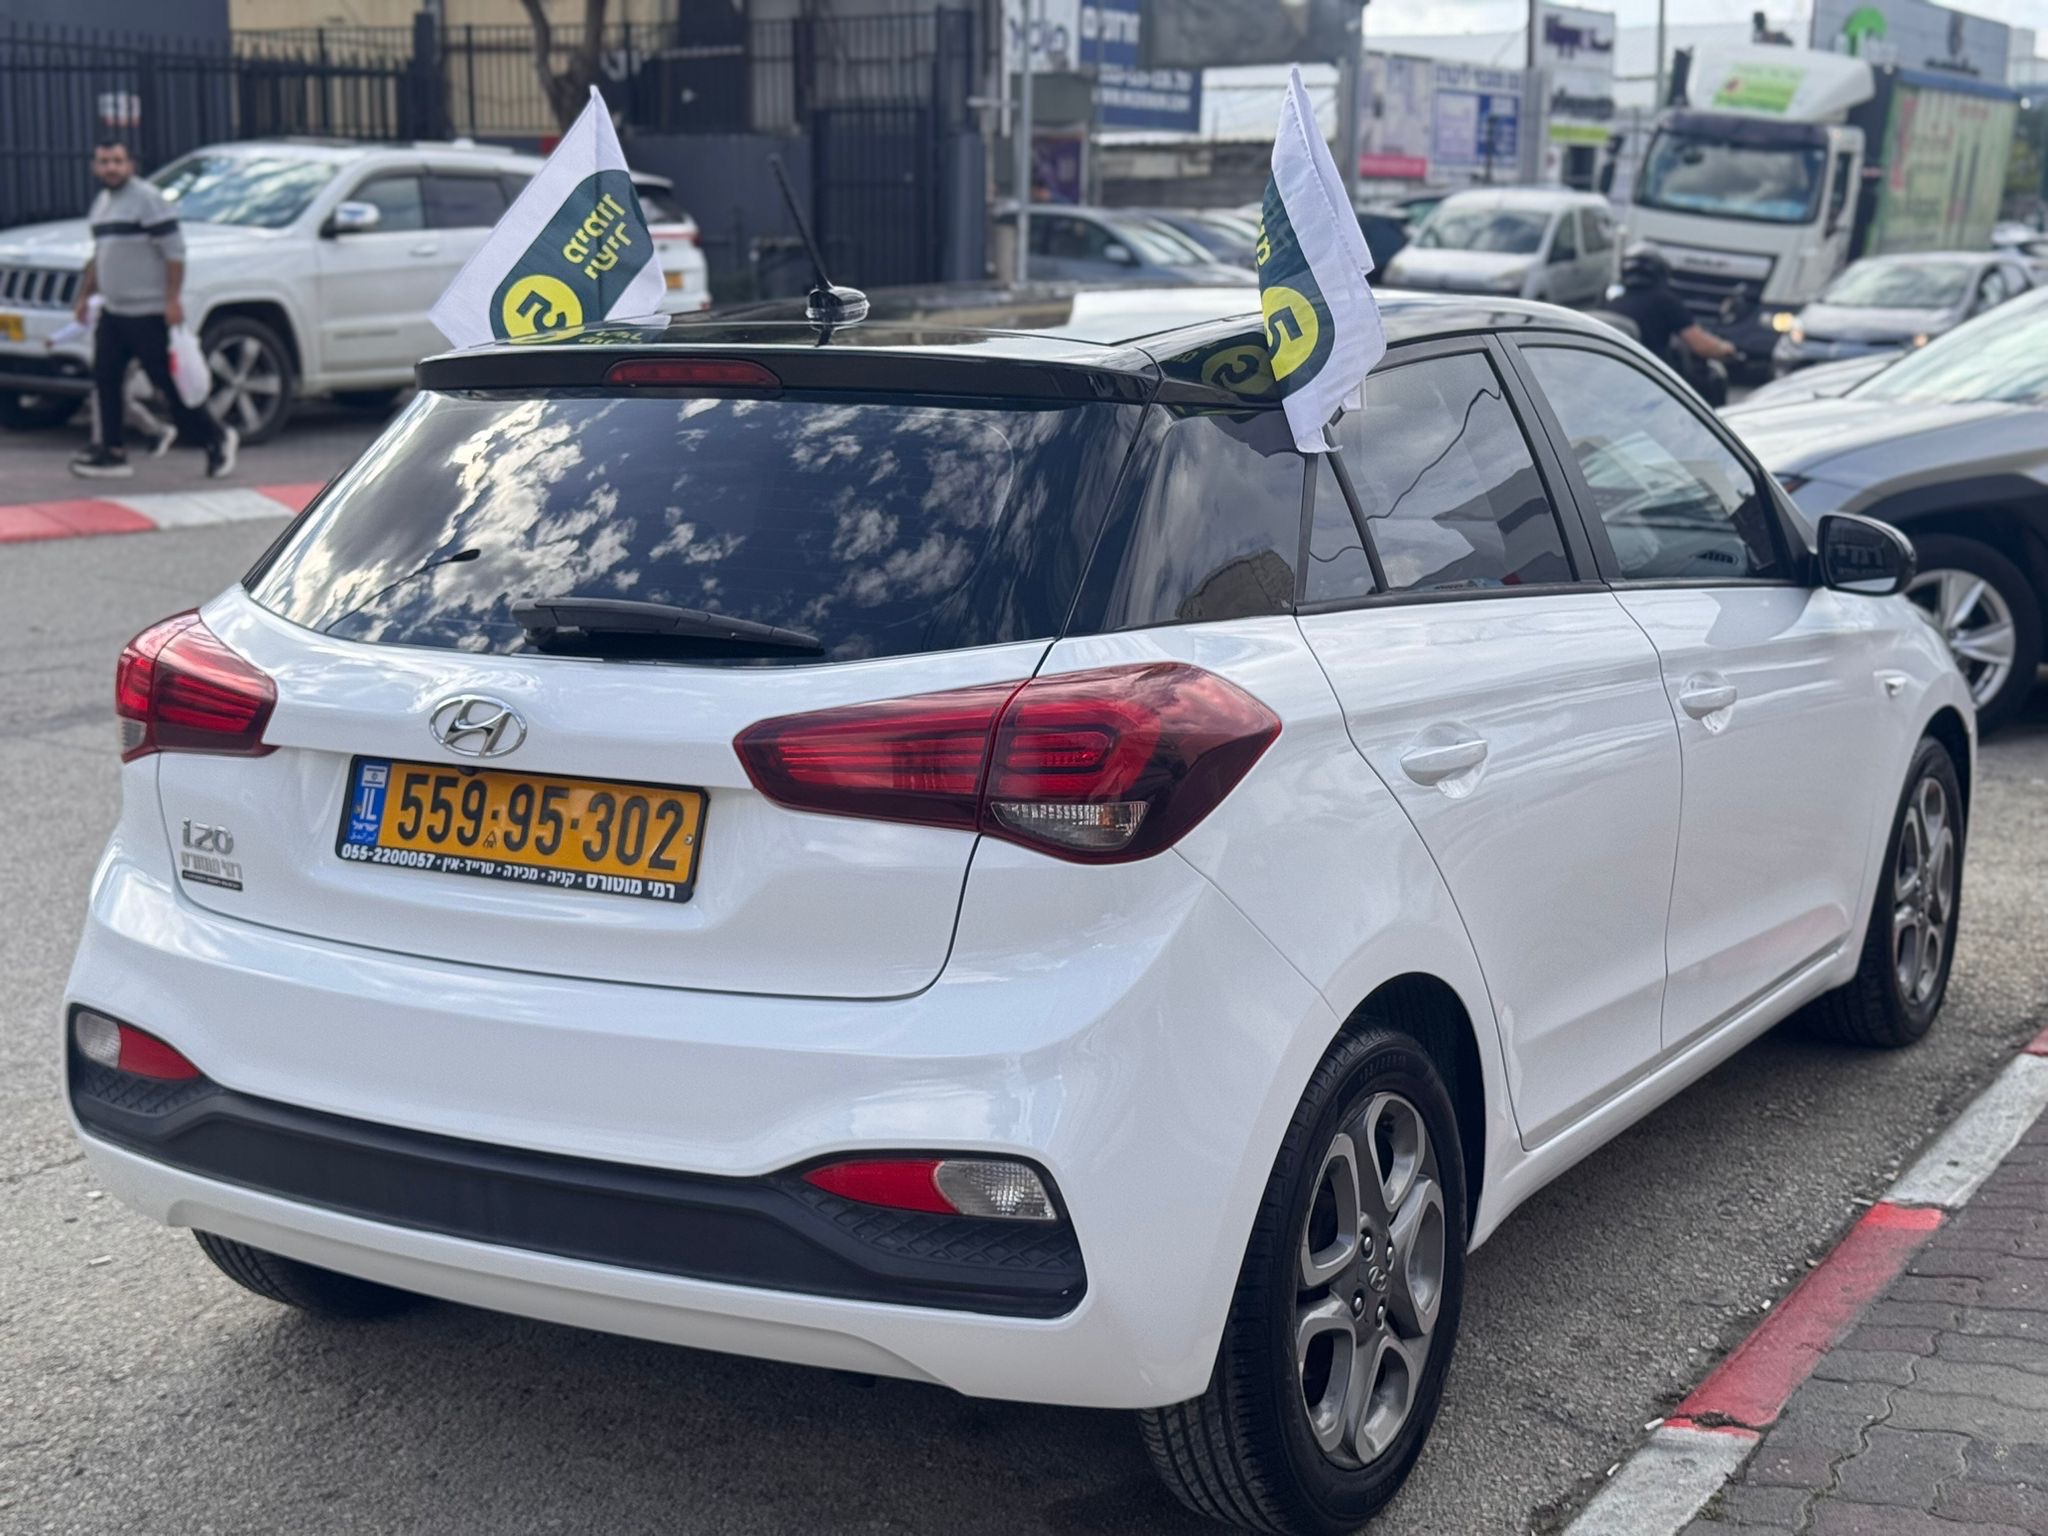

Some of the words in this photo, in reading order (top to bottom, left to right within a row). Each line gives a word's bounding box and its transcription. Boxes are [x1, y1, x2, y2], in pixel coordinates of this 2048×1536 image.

[360, 787, 377, 820] IL
[183, 816, 234, 855] i20
[341, 843, 436, 869] 055-2200057
[503, 864, 538, 881] מכירה
[547, 869, 576, 888] קניה
[585, 873, 643, 895] מוטורס
[648, 880, 676, 900] רמי
